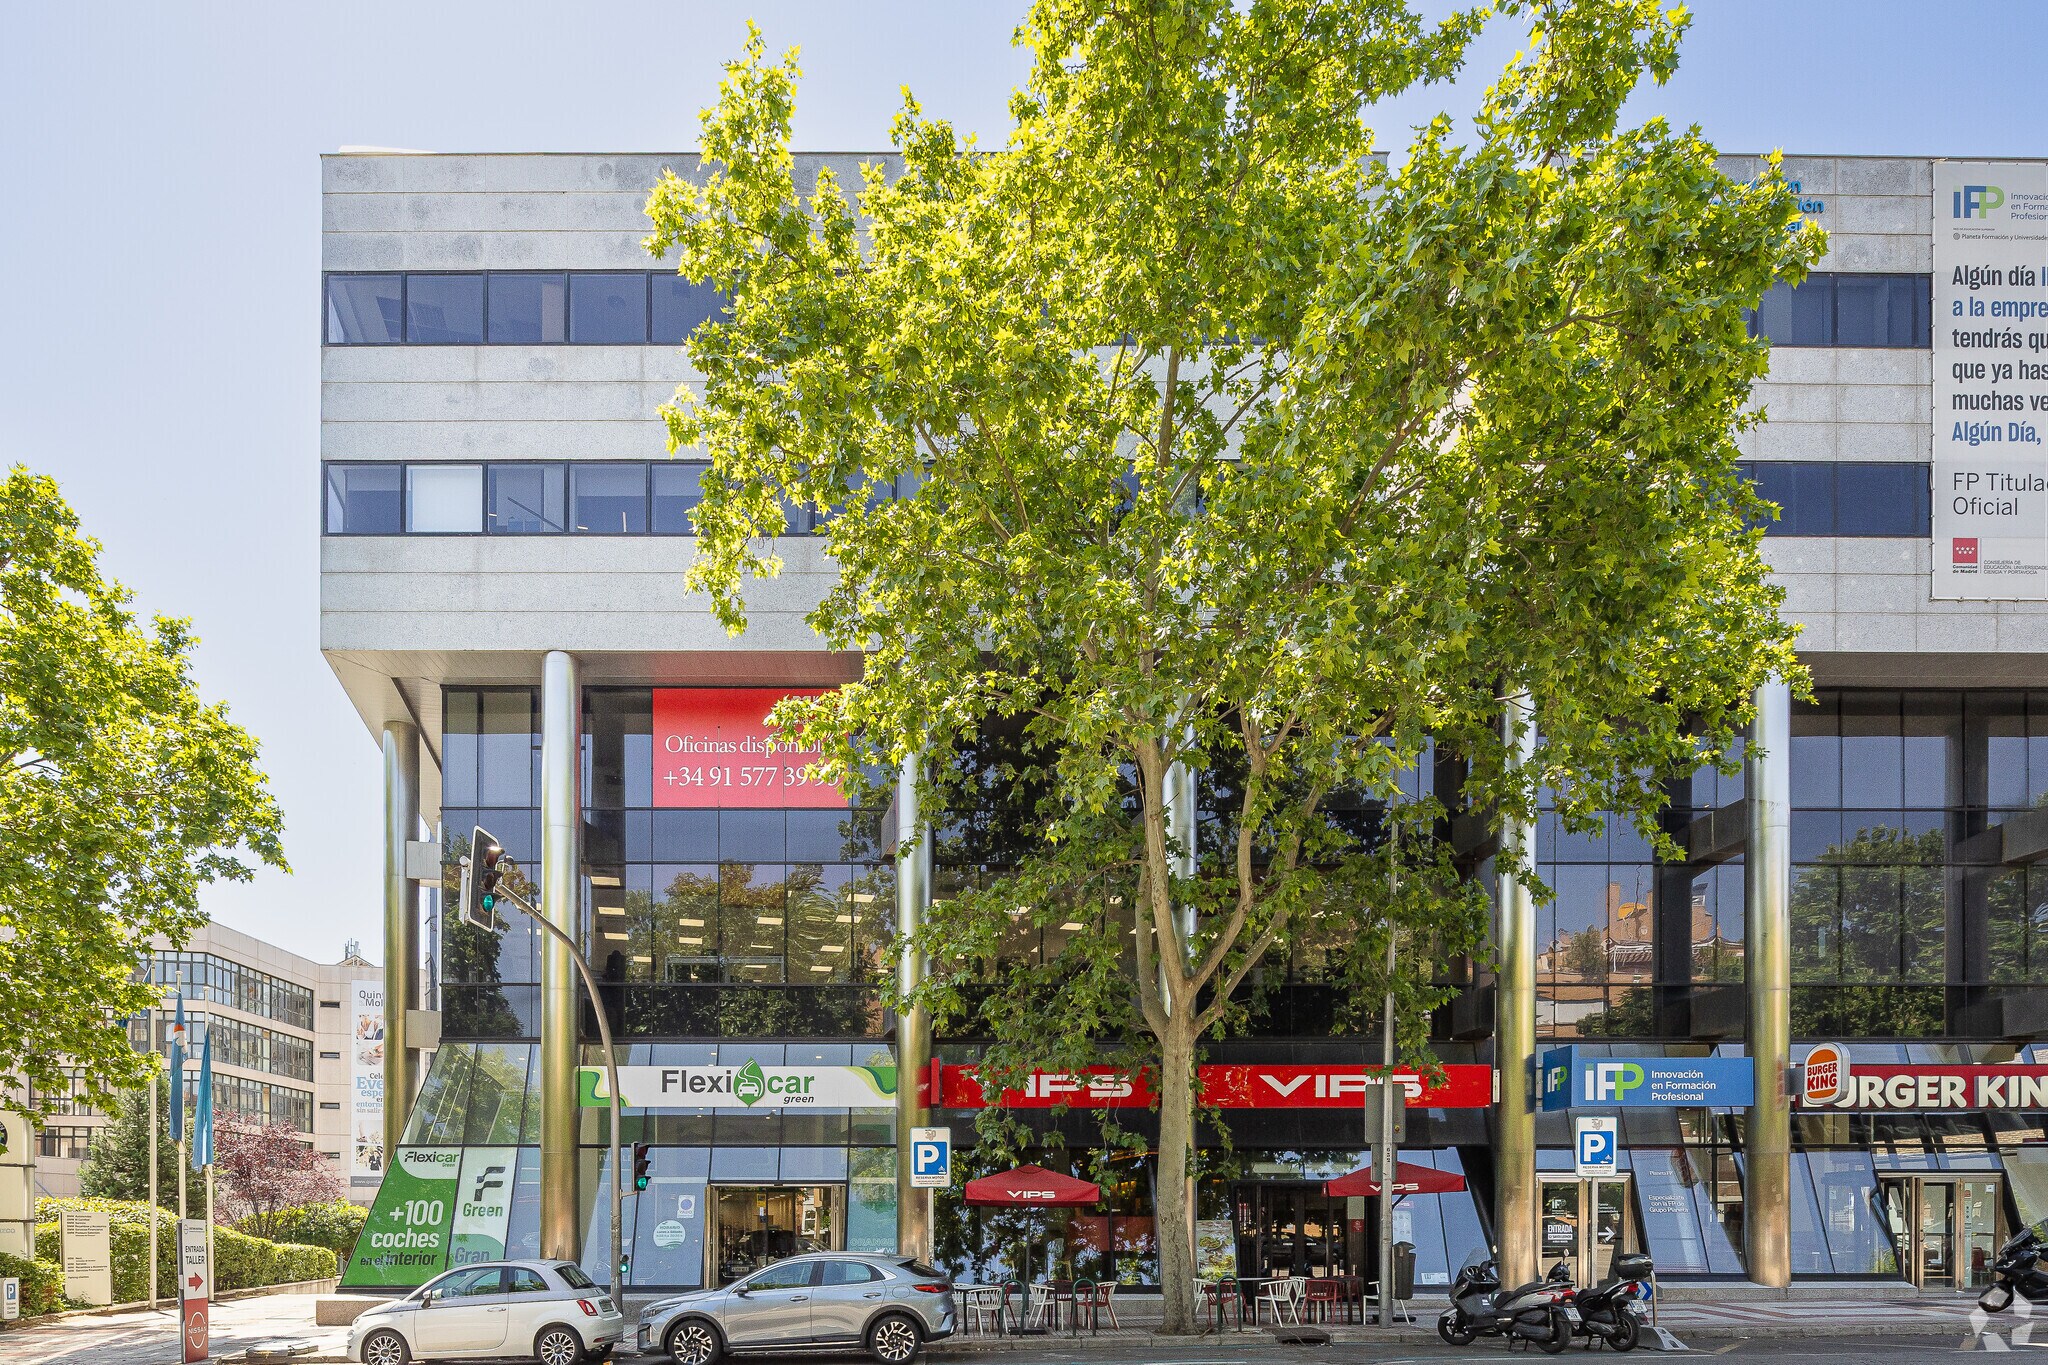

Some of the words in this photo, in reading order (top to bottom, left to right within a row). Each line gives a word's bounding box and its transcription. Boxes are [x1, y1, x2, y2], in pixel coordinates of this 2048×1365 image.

[1952, 264, 2002, 290] Algún
[2008, 265, 2035, 286] día
[1952, 300, 1963, 317] a
[1969, 296, 1985, 317] la
[1952, 326, 2022, 348] tendrás
[1952, 362, 1985, 384] que
[1991, 363, 2013, 384] ya
[1952, 390, 2024, 411] muchas
[1951, 420, 2002, 447] Algún
[2008, 420, 2042, 446] Día,
[1953, 472, 1980, 491] FP
[1953, 496, 2018, 516] Oficial
[665, 734, 737, 754] Oficinas
[663, 766, 704, 787] +34
[709, 766, 732, 787] 91
[740, 766, 778, 787] 577
[783, 766, 810, 787] 39
[1651, 1069, 1704, 1079] Innovación
[1807, 1062, 1838, 1077] BURGER
[1665, 1080, 1717, 1090] Formación
[1807, 1073, 1838, 1091] KING
[783, 1095, 815, 1105] green
[1651, 1092, 1704, 1101] Profesional
[1583, 1133, 1606, 1162] P
[404, 1151, 460, 1163] Flexicar
[917, 1144, 940, 1173] P
[1006, 1190, 1056, 1199] VIPS
[1369, 1183, 1420, 1192] VPS
[389, 1199, 444, 1226] +100
[462, 1202, 504, 1217] Green
[370, 1227, 440, 1248] coches
[1547, 1224, 1573, 1233] ENTRADA
[185, 1245, 205, 1253] ENTRADA
[360, 1256, 372, 1266] en
[374, 1254, 383, 1266] el
[386, 1249, 438, 1266] interior
[454, 1246, 490, 1264] Gran
[185, 1255, 205, 1264] TALLER
[7, 1284, 15, 1299] P
